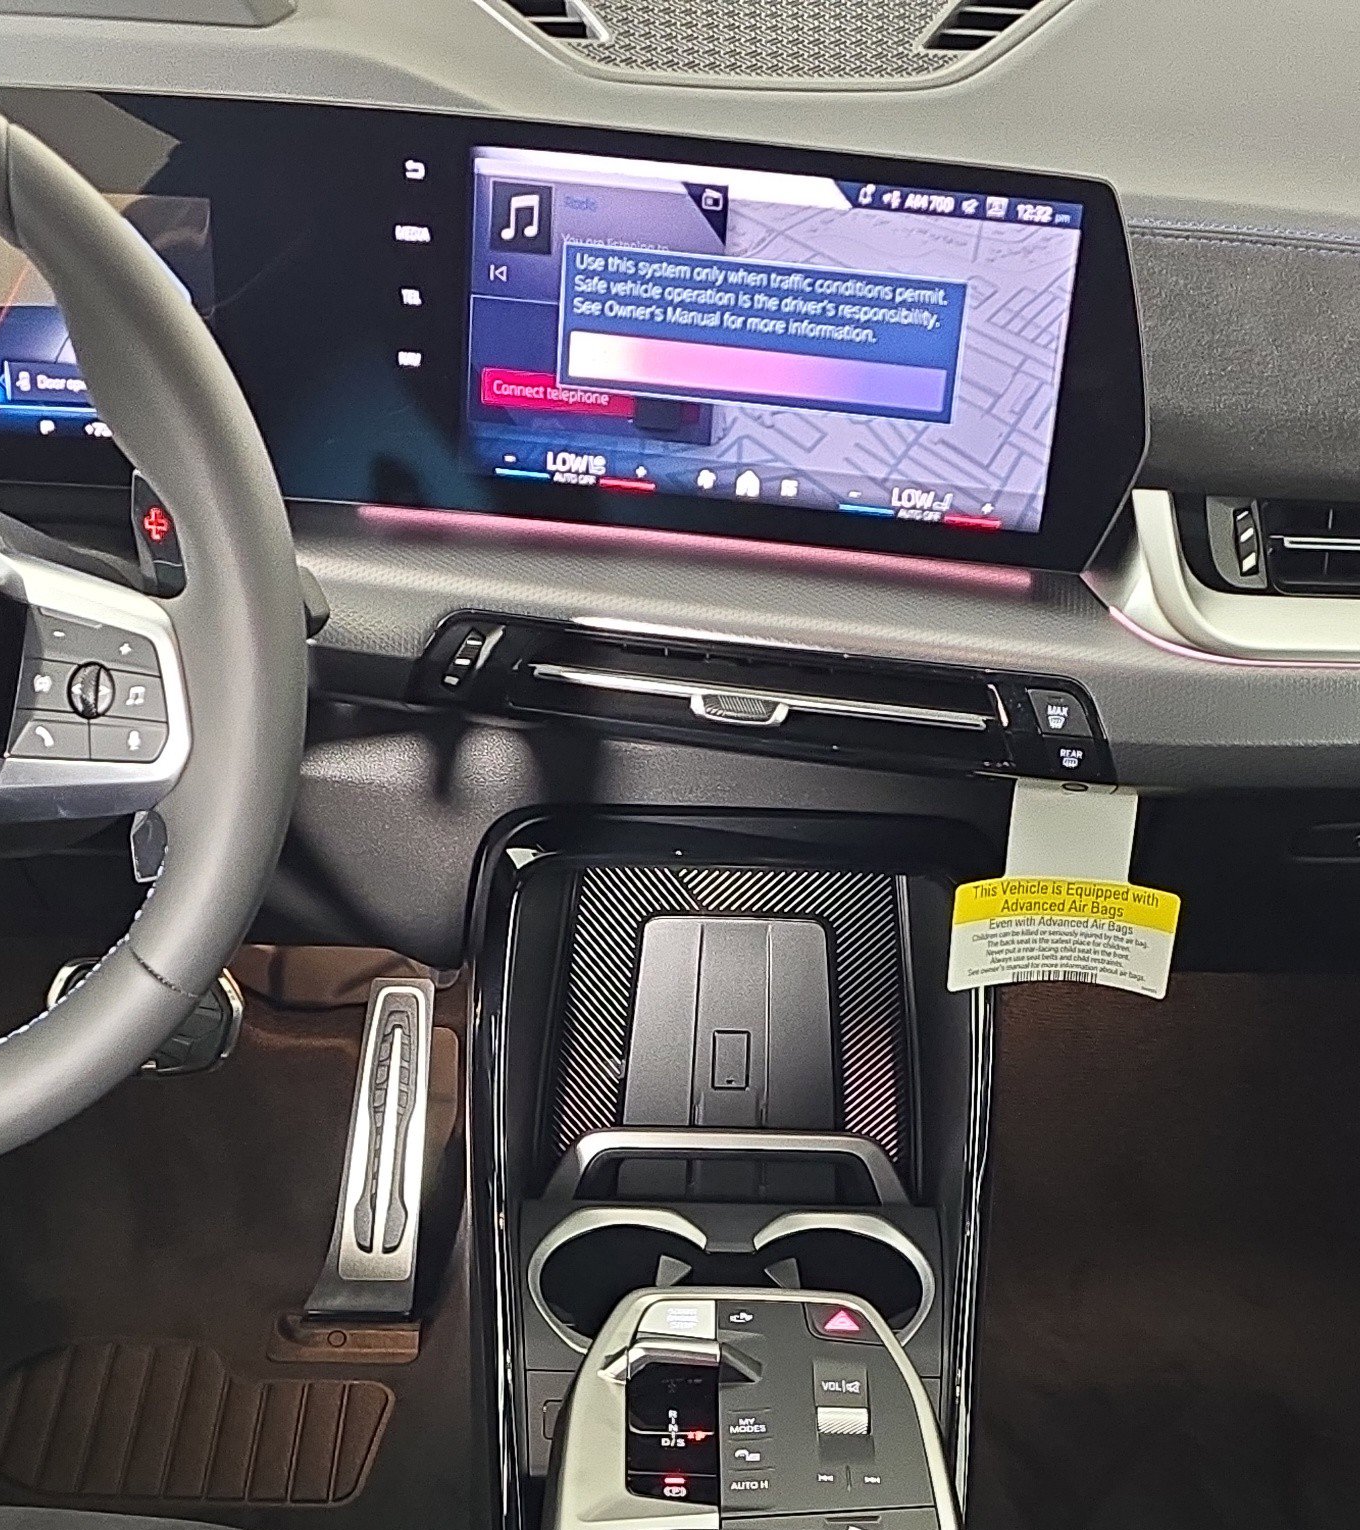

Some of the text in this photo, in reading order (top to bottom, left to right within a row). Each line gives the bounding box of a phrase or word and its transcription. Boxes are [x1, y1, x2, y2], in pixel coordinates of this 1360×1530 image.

[575, 252, 948, 306] Use this system only when traffic conditions permit.
[574, 275, 940, 330] Safe vehicle operation is the driver's responsibility.
[572, 297, 877, 343] See Owner's Manual for more information.
[493, 379, 609, 406] Connect telephone
[546, 451, 587, 472] LOW
[891, 487, 933, 508] LOW
[1047, 704, 1068, 716] MAX
[1060, 748, 1083, 759] REAR
[973, 881, 1159, 908] This Vehicle is Equipped with
[1001, 899, 1124, 919] Advanced Air Bags
[989, 916, 1133, 936] Even with Advanced Air Bags
[972, 932, 997, 942] Children
[1048, 930, 1077, 938] seriously
[1079, 931, 1103, 940] injured
[1104, 933, 1112, 942] by
[1134, 938, 1148, 949] bag.
[987, 940, 998, 948] The
[1000, 938, 1015, 946] back
[1017, 937, 1030, 945] seat
[1051, 937, 1071, 945] safest
[1073, 938, 1091, 947] place
[1103, 941, 1130, 952] children.
[986, 948, 1003, 956] Never
[1004, 947, 1016, 955] put
[1022, 946, 1058, 954] rear-facing
[1077, 947, 1092, 955] seat
[1100, 949, 1112, 957] the
[990, 956, 1012, 964] Always
[1073, 954, 1090, 962] child
[967, 968, 980, 976] See
[981, 965, 1005, 974] owner's
[1006, 962, 1030, 970] manual
[1059, 962, 1098, 971] information
[1099, 966, 1118, 975] about
[821, 1380, 841, 1391] VOL
[668, 1409, 678, 1418] R
[668, 1423, 678, 1432] N
[729, 1424, 766, 1433] MODES
[730, 1480, 768, 1490] AUTO H
